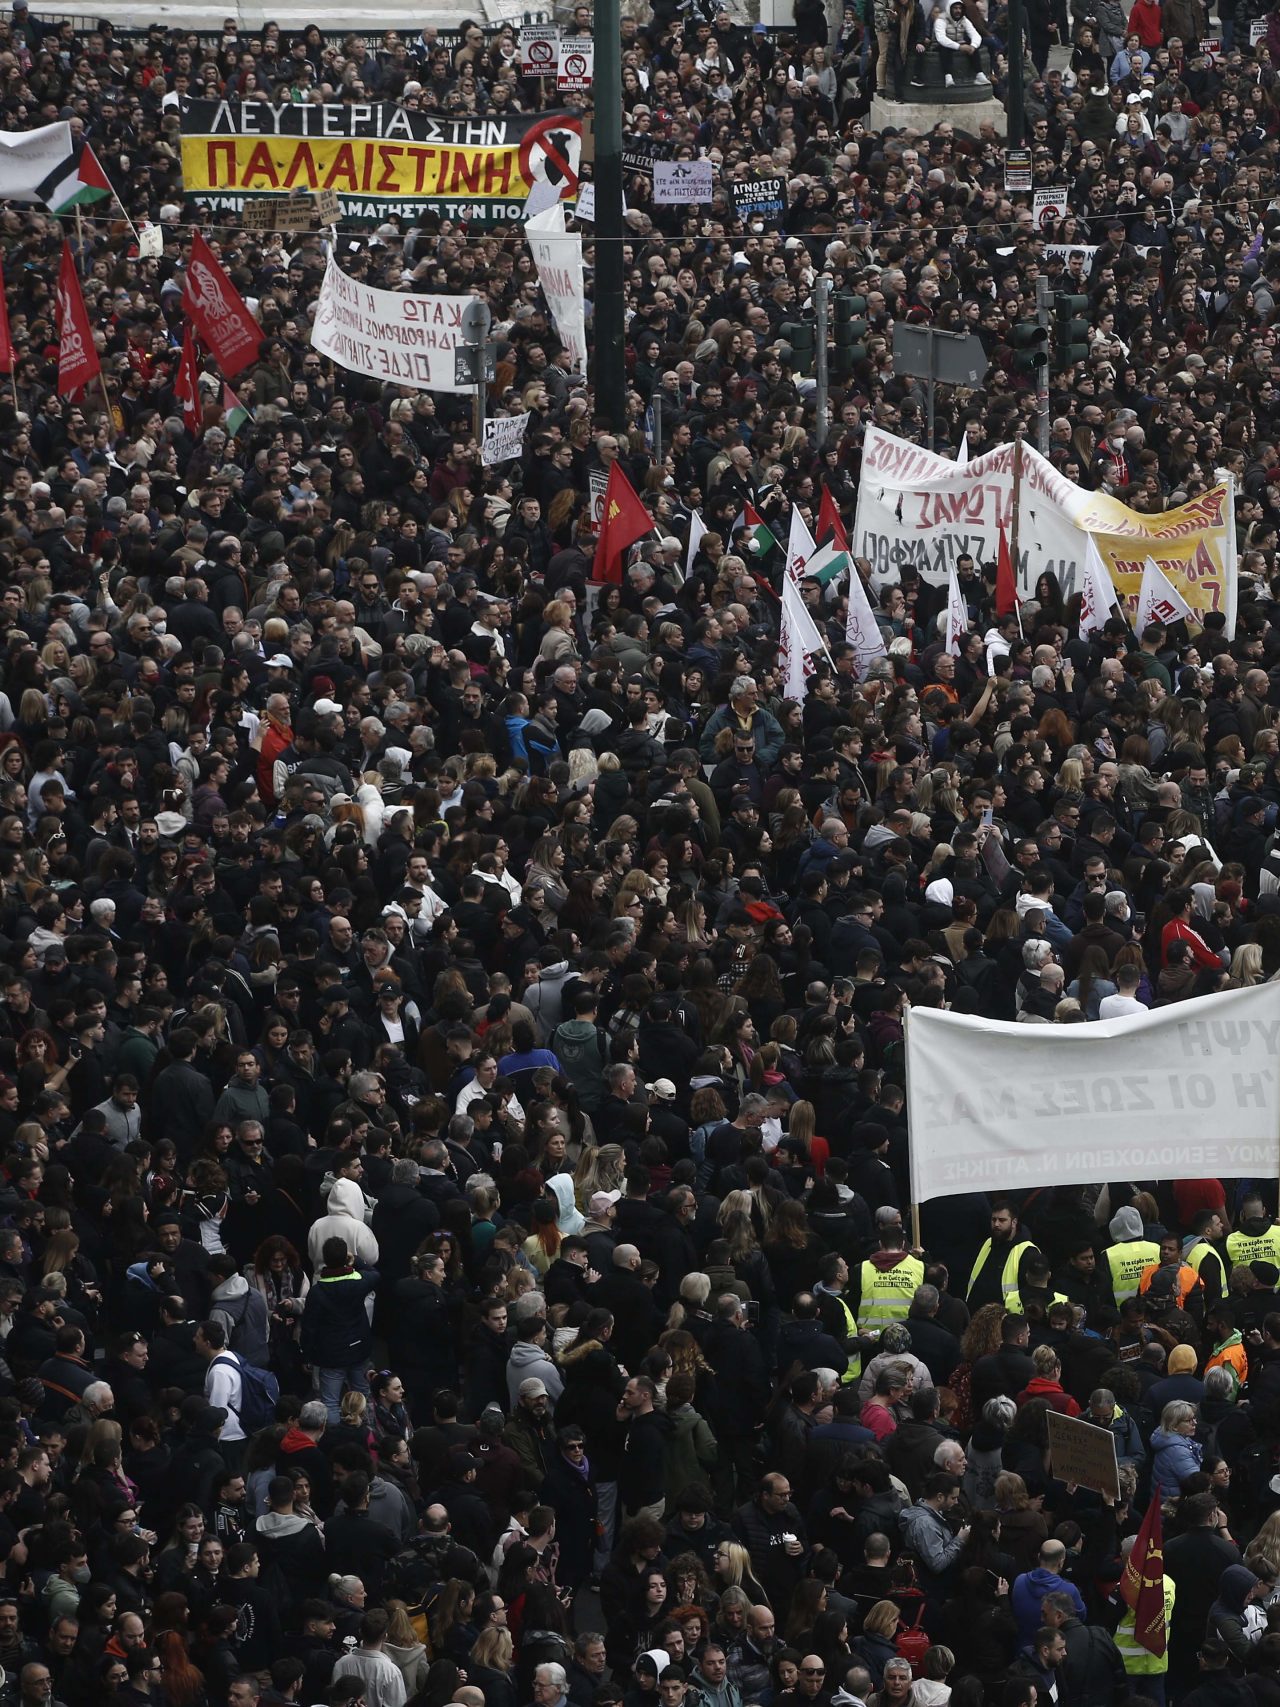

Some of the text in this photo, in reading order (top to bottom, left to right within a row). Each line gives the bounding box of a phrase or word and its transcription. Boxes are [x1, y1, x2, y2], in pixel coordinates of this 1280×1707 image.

[210, 100, 507, 145] ΛΕΥΤΕΡΙΑ ΣΤΗΝ
[622, 152, 636, 164] ΤΑΝ
[207, 140, 513, 194] ΠΑΛΑΙΣΤΙΝΗ
[733, 179, 781, 195] ΑΓΝΩΣΤΟ
[1037, 193, 1064, 201] ΚΥΒΕΡΝΗΣΗ
[446, 204, 486, 219] ΤΟΝ
[1263, 1238, 1275, 1246] τους
